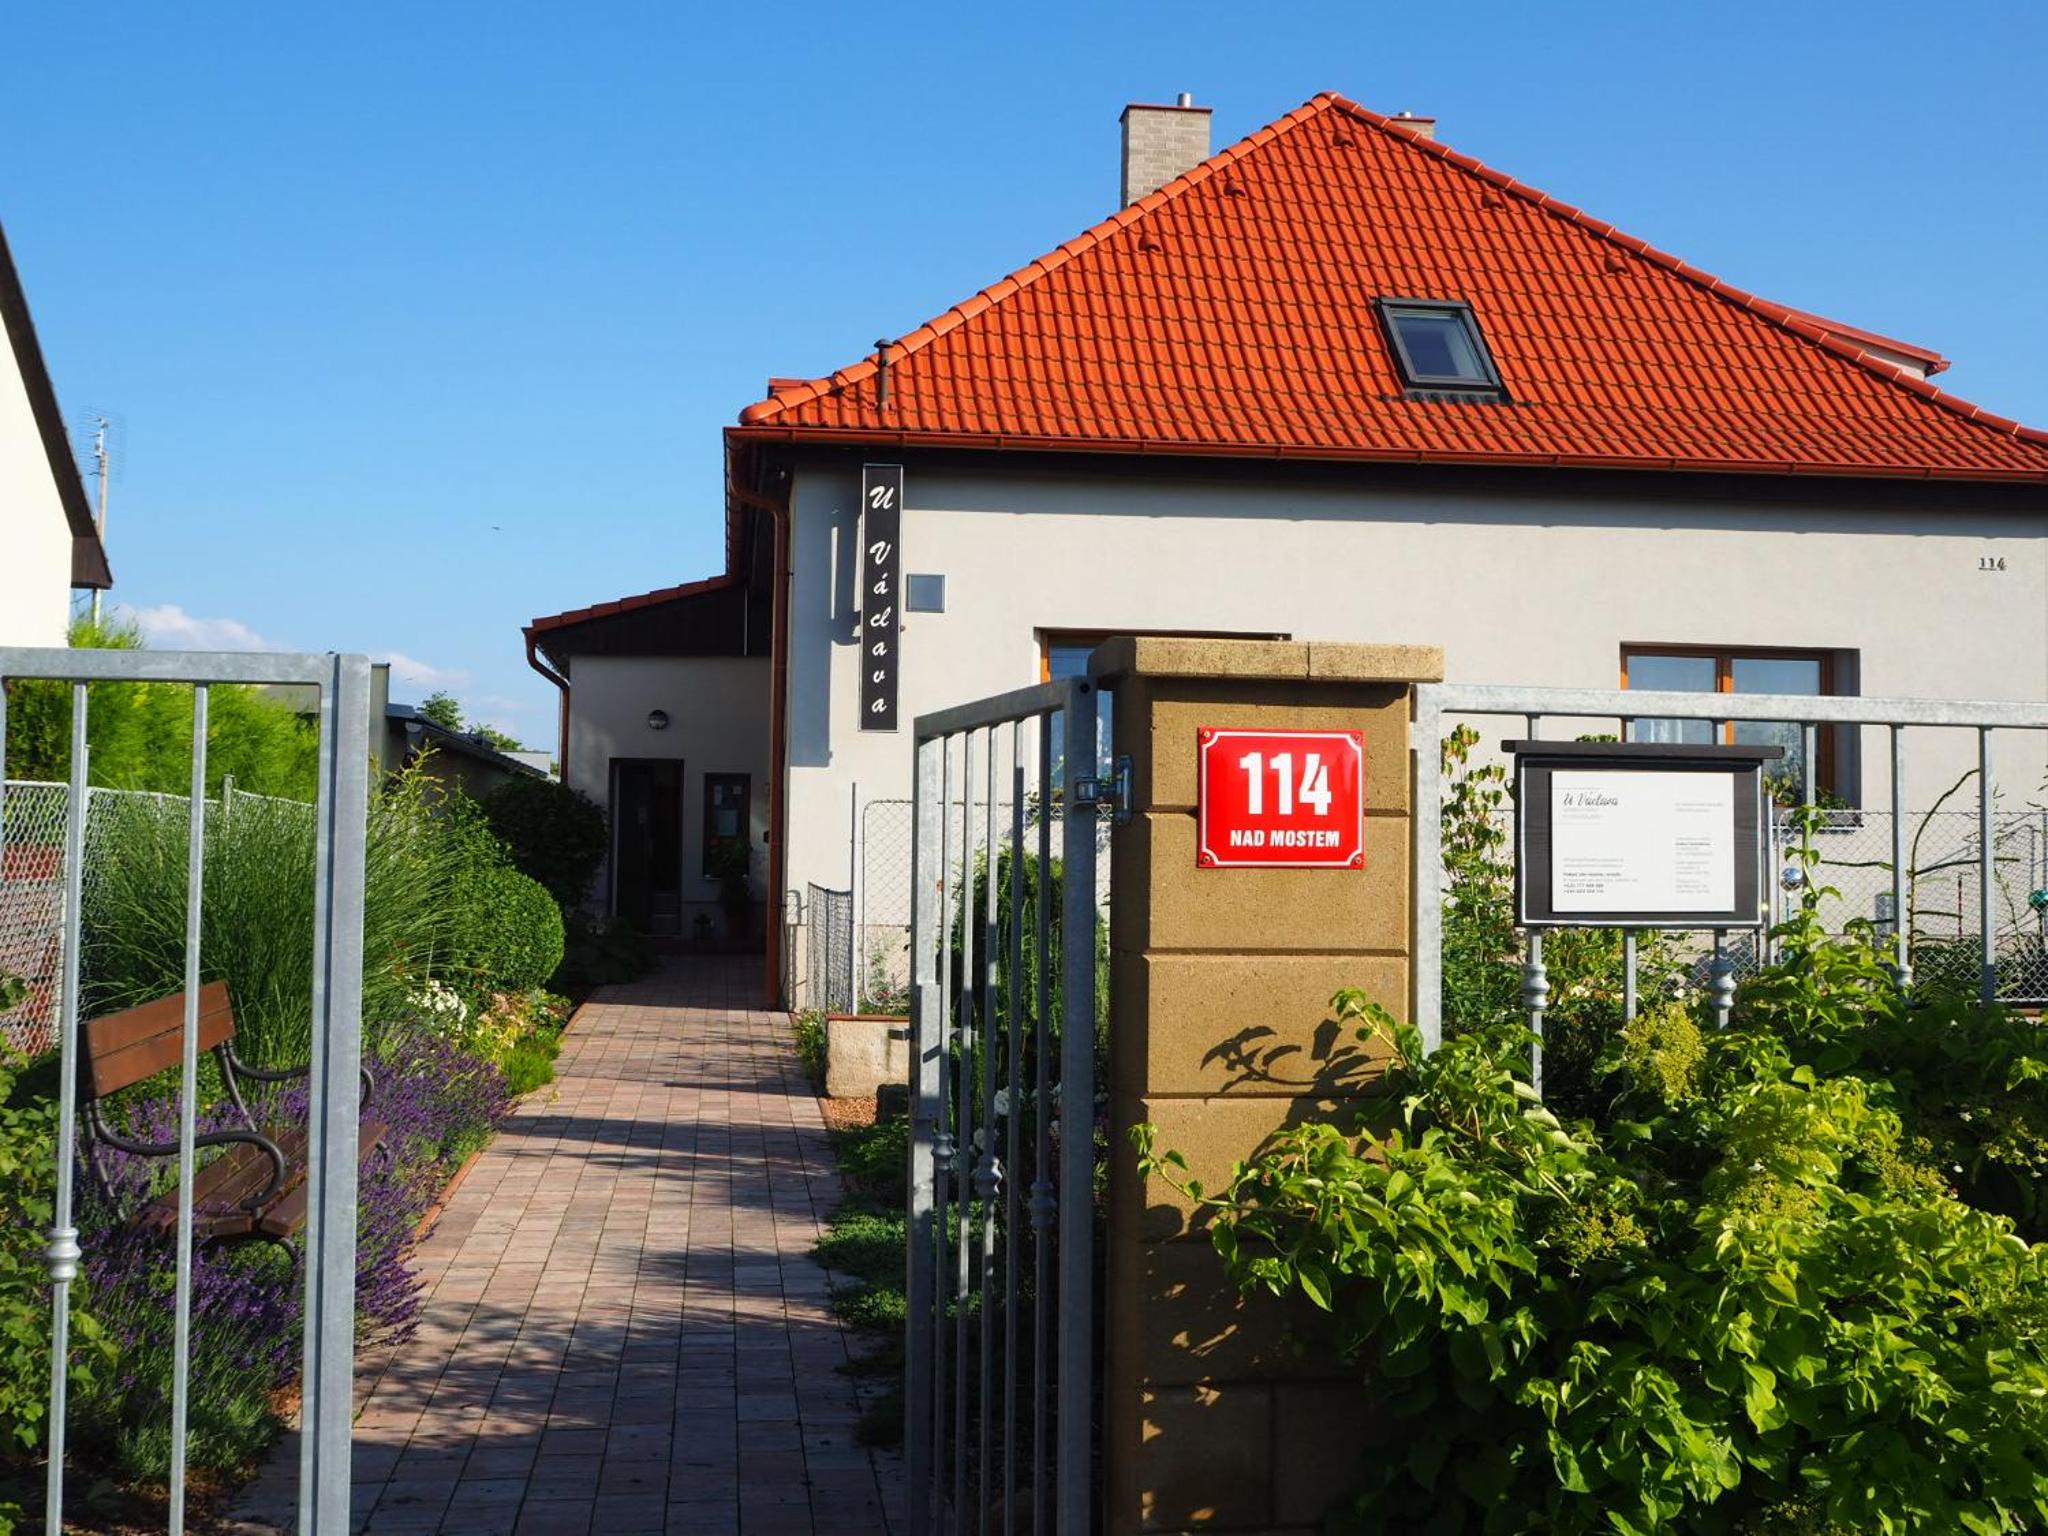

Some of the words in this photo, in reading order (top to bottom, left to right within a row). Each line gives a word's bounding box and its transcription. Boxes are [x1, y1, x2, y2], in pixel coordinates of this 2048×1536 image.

[869, 485, 895, 509] U
[1979, 557, 2007, 571] 114
[869, 541, 891, 713] Václava
[1239, 752, 1332, 815] 114
[1230, 830, 1265, 847] NAD
[1270, 830, 1340, 847] MOSTEM
